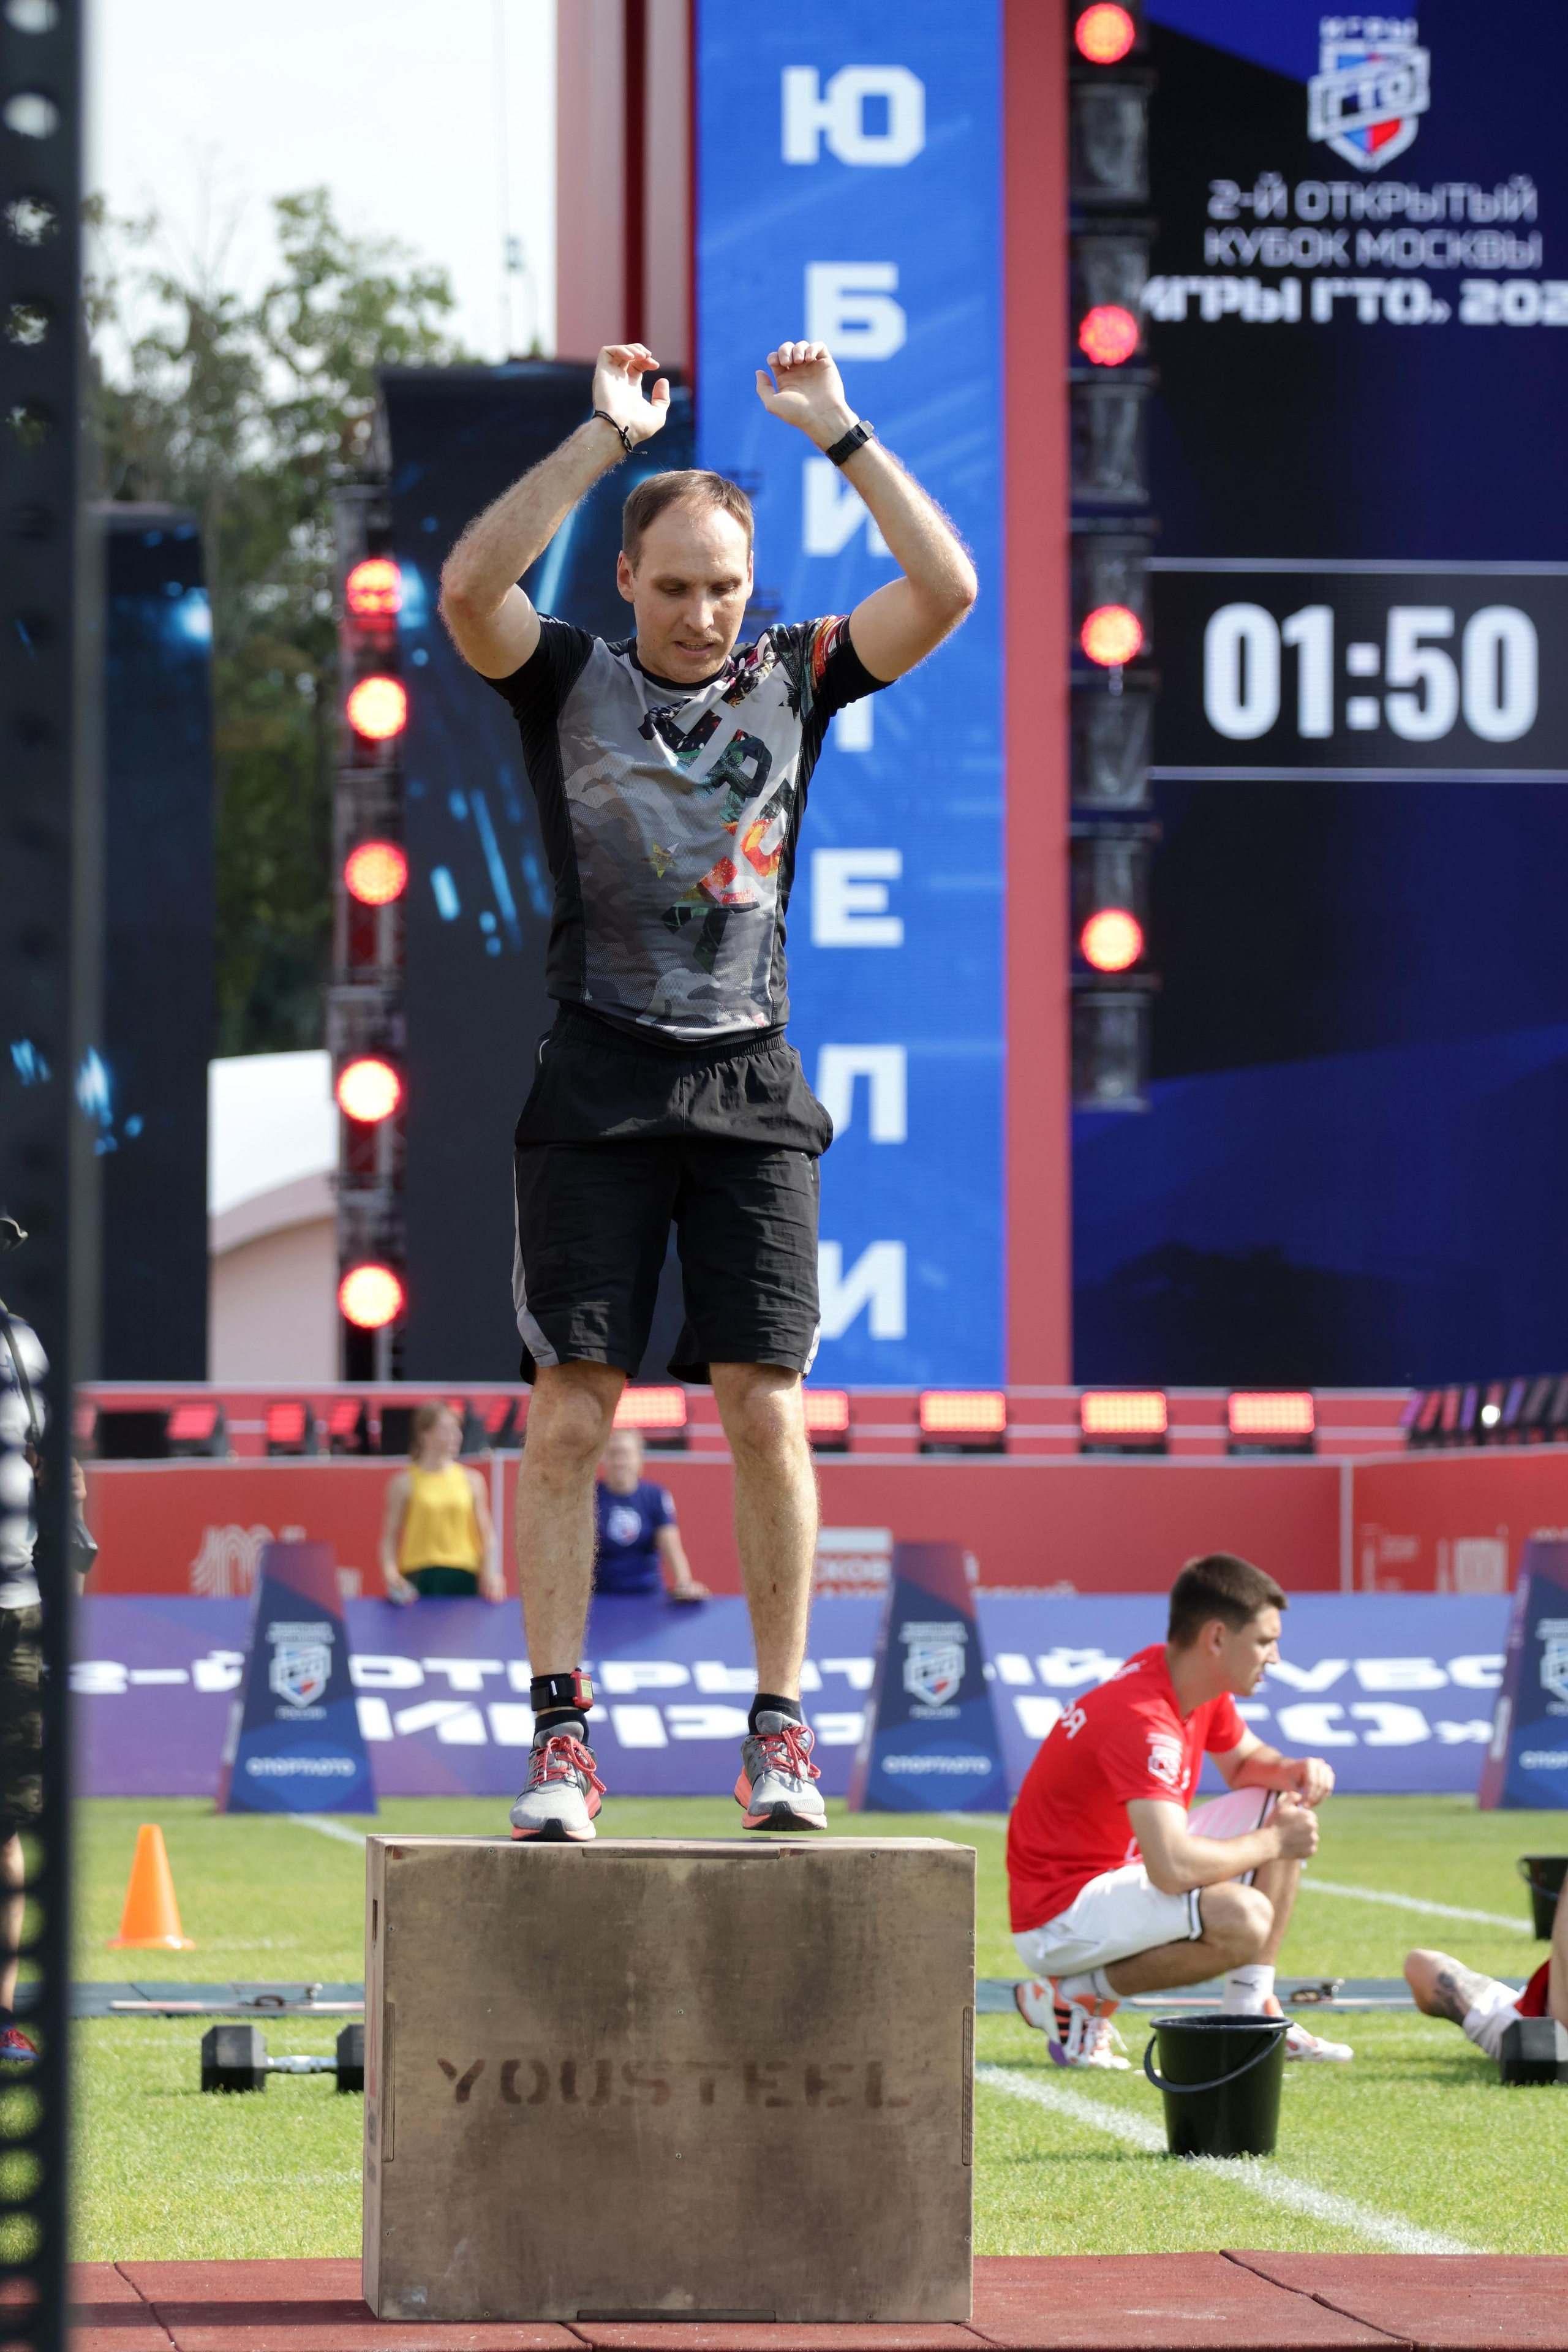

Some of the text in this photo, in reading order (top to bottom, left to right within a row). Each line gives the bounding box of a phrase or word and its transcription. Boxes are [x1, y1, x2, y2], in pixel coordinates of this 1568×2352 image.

[1208, 171, 1537, 223] 2-Й ОТКРЫТЫЙ
[1204, 227, 1542, 270] КУБОК МОСКВЫ
[1204, 602, 1539, 742] 01:50
[437, 2059, 911, 2109] YOUSTEEL
